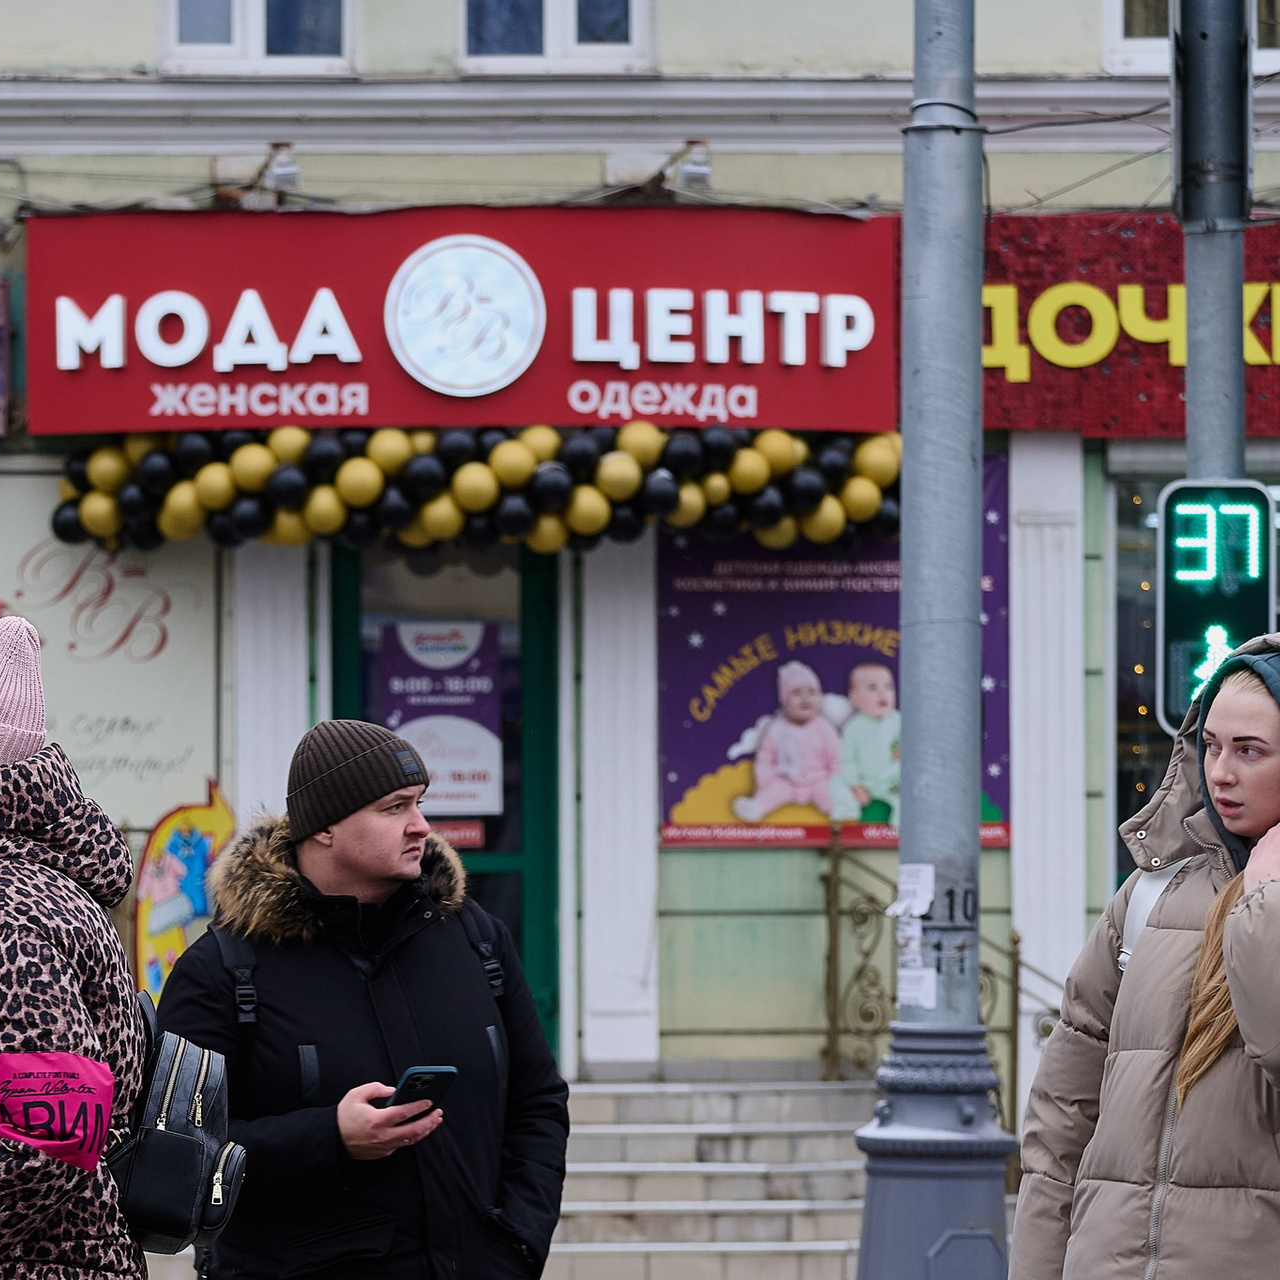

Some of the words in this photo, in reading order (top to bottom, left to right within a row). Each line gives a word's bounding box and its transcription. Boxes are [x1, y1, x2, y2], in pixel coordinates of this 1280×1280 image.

[54, 286, 364, 373] МОДА
[571, 286, 876, 370] ЦЕНТР
[982, 281, 1280, 383] ДОЧК
[148, 381, 370, 417] женская
[567, 379, 759, 421] одежда
[1174, 502, 1261, 582] 37
[688, 633, 779, 724] САМЫЕ
[783, 619, 900, 658] НИЗКИЕ
[18, 1071, 47, 1079] COMPLETE
